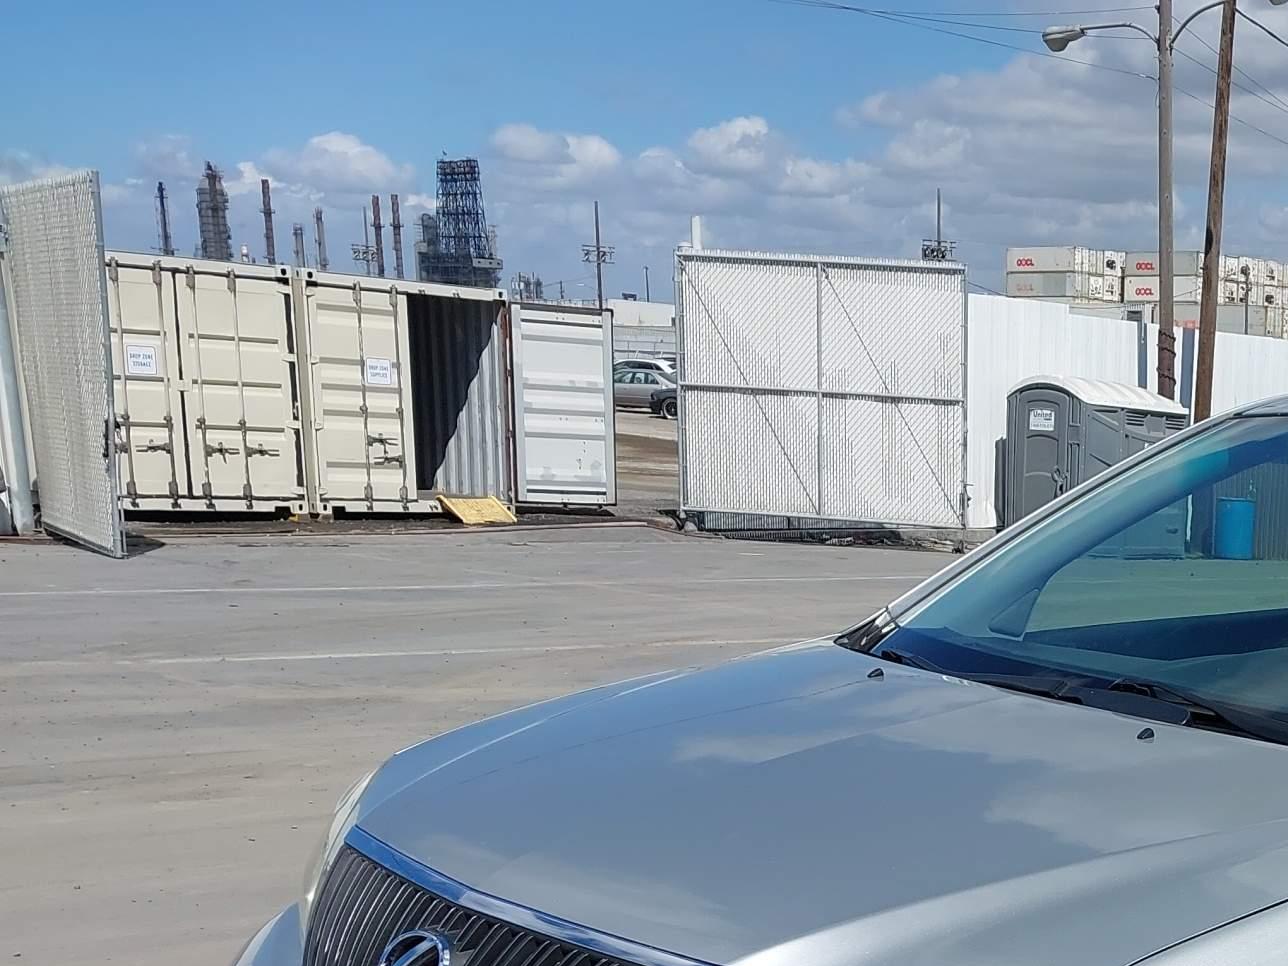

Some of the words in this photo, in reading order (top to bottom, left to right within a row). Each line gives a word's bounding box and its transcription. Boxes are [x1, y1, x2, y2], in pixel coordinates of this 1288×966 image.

[1016, 258, 1034, 267] OOCL
[1136, 262, 1155, 271] OOCL
[1135, 287, 1154, 296] OOCL
